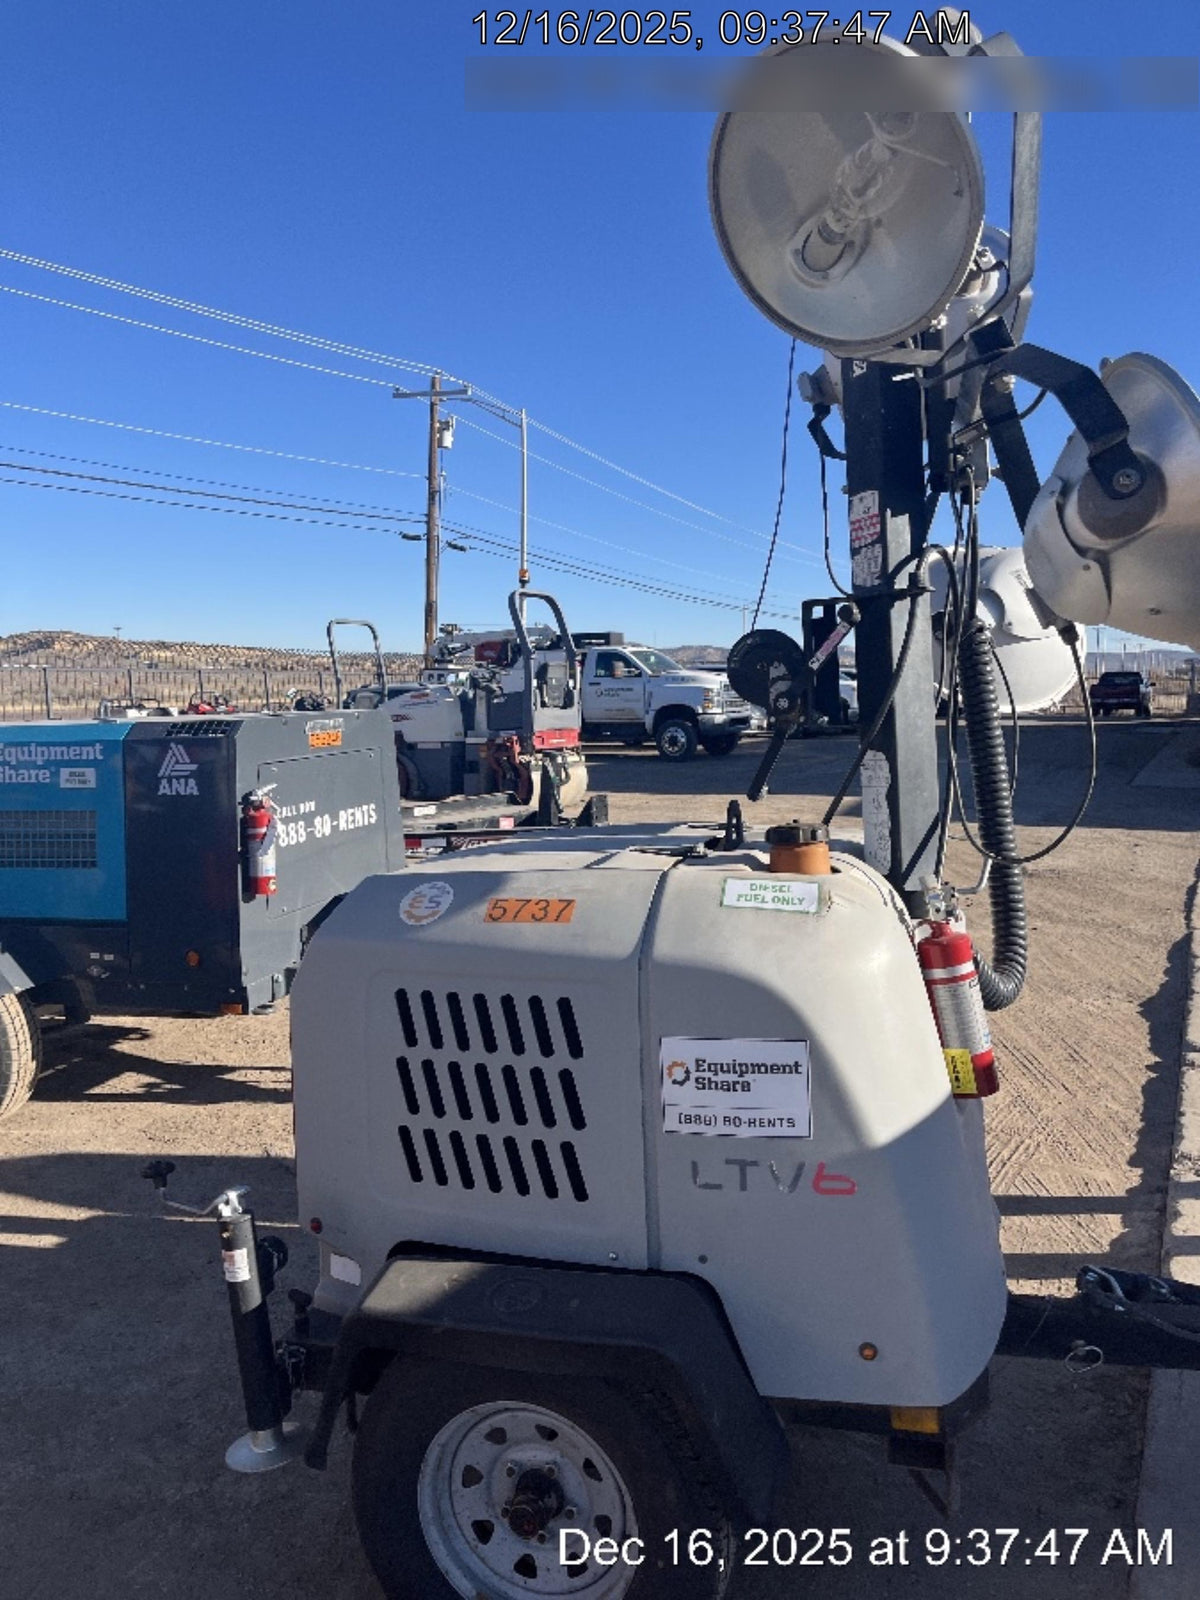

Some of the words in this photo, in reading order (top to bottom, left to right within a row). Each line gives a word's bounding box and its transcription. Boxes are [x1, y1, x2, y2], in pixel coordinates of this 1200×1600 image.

[157, 778, 200, 796] ANA
[736, 893, 769, 904] FUEL
[771, 895, 805, 906] ONLY
[488, 898, 575, 922] 5737
[694, 1058, 803, 1078] Equipment
[694, 1077, 751, 1093] Share
